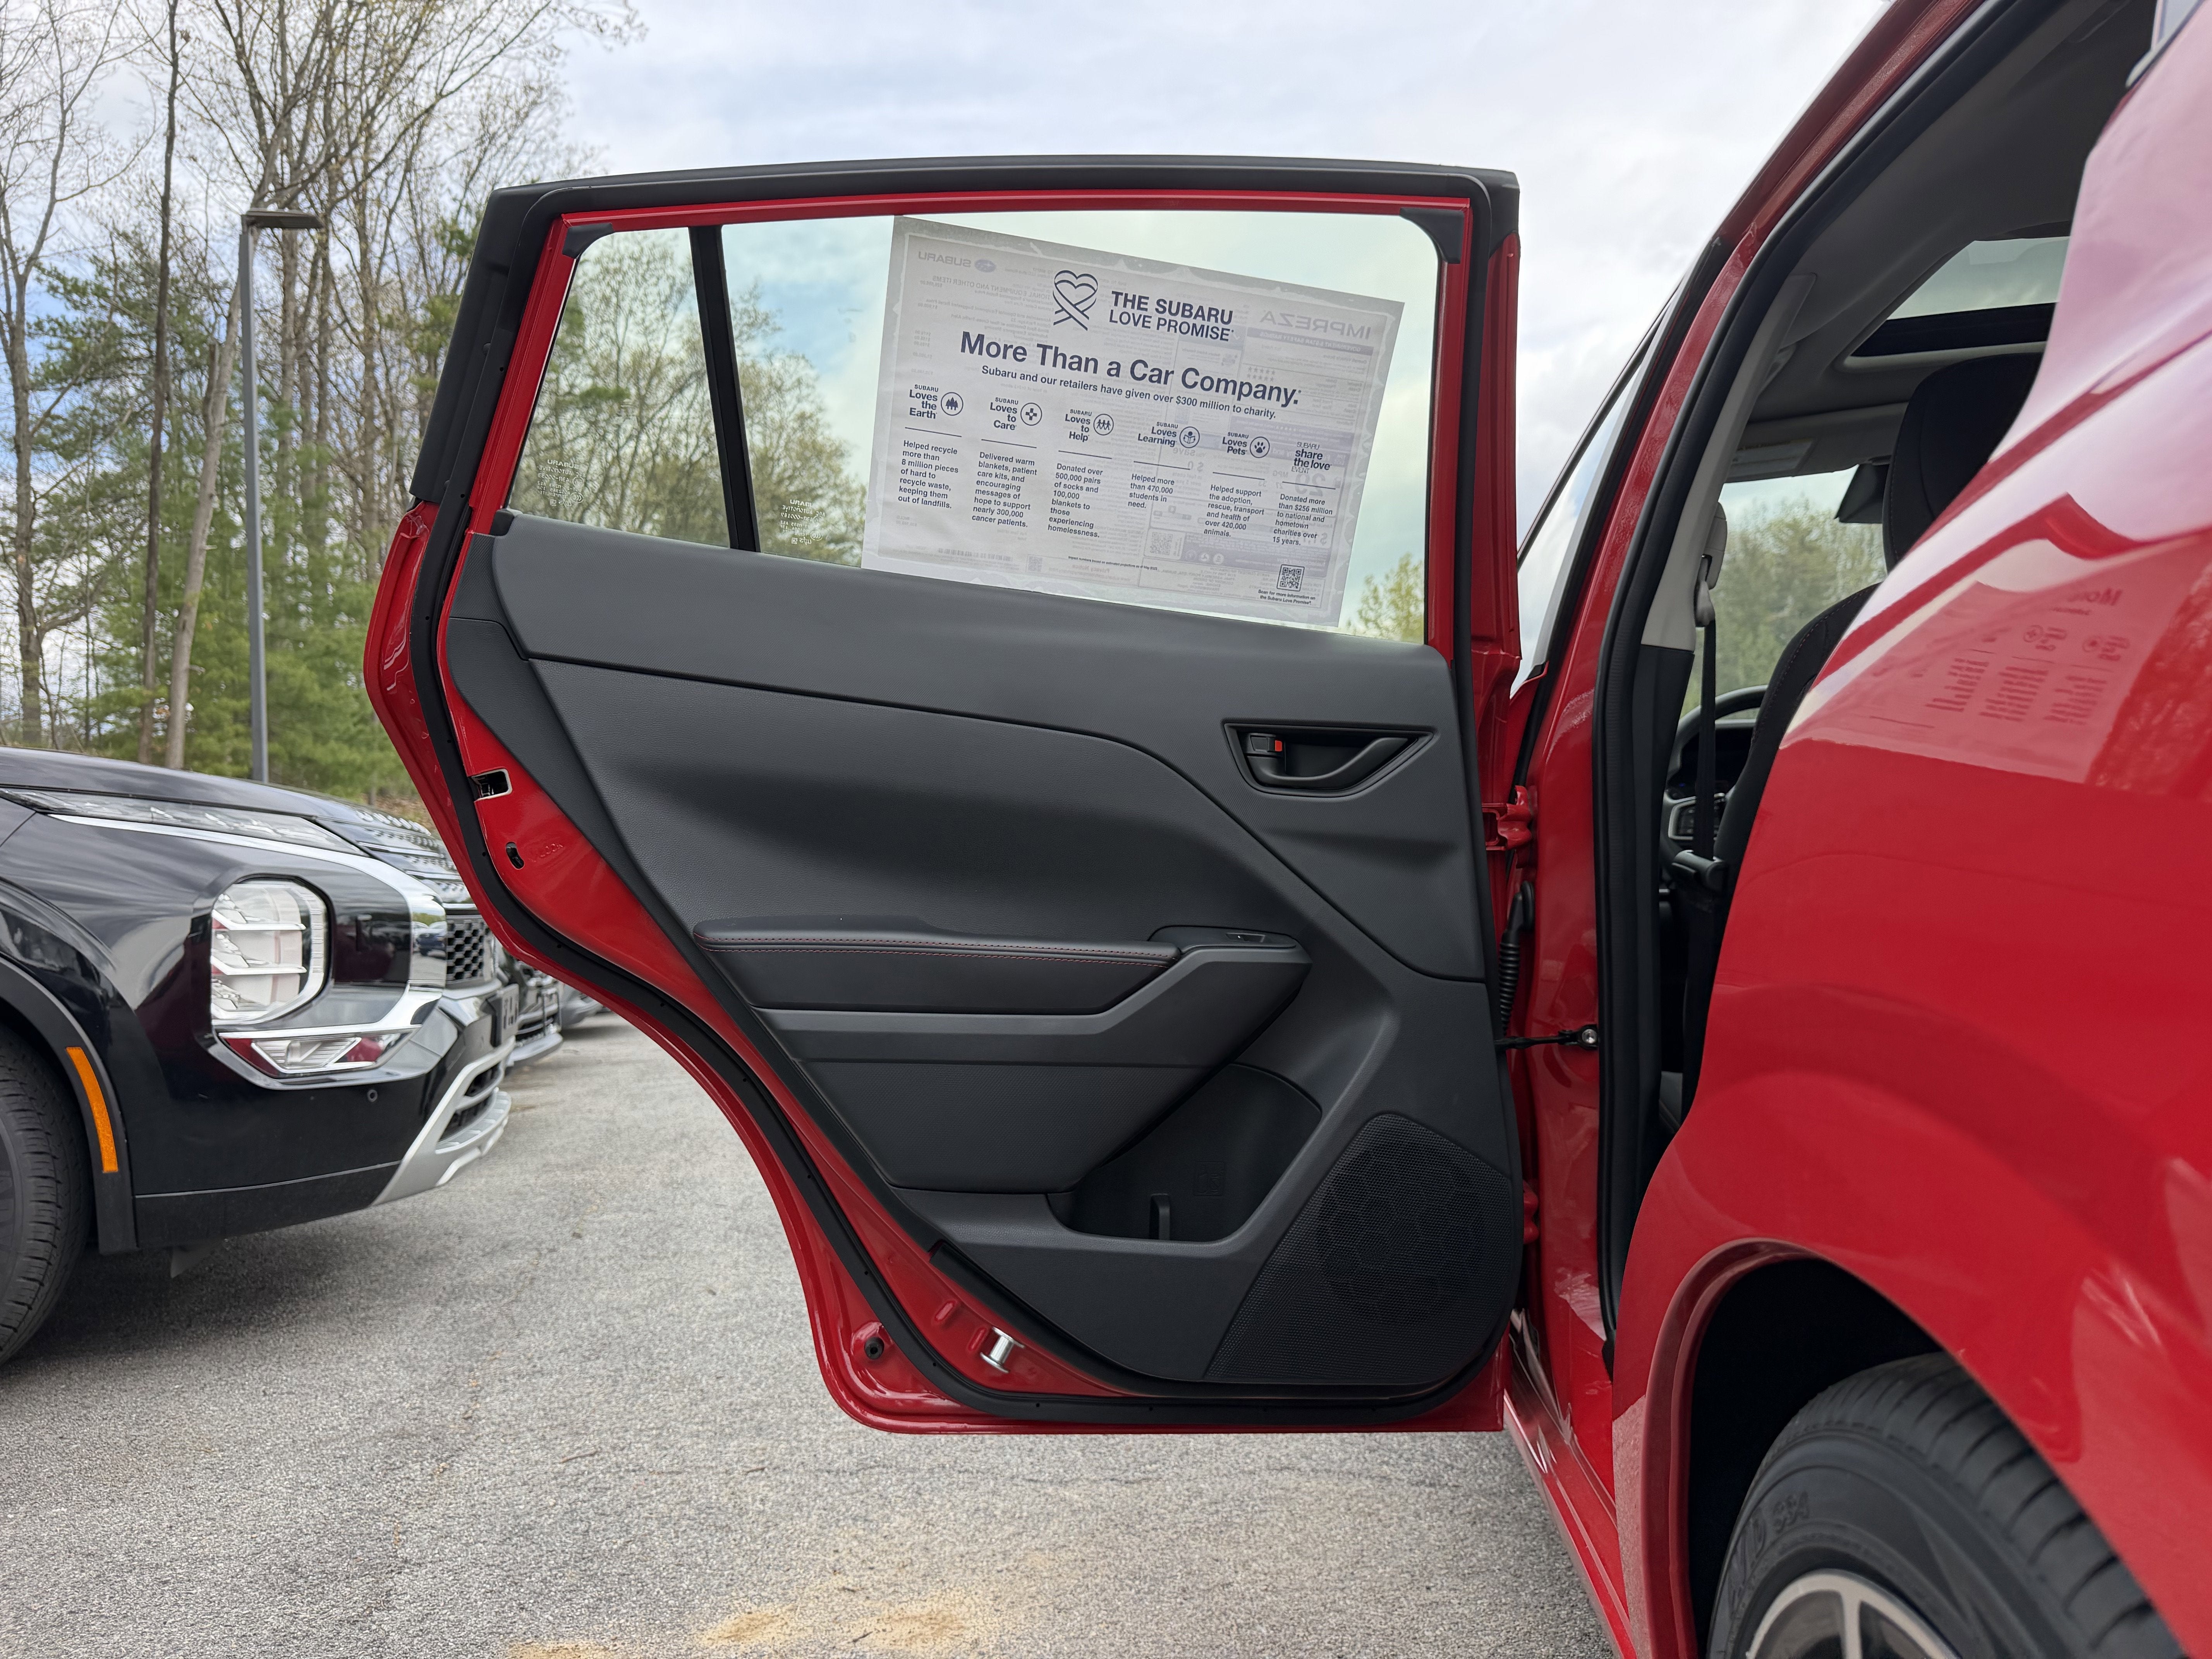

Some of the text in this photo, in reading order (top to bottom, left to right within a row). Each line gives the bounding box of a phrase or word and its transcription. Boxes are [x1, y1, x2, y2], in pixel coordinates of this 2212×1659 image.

[1111, 290, 1233, 325] THE SUBARU
[1109, 309, 1152, 329] LOVE
[960, 330, 1027, 362] More
[1036, 343, 1098, 374] Than
[1106, 361, 1121, 378] a
[1130, 359, 1175, 385] Car
[914, 384, 939, 392] SUBARU
[981, 365, 1276, 420] Subaru and our retailers have given over $300 million to charity.
[909, 389, 938, 402] Loves
[994, 397, 1018, 405] SUBARU
[921, 400, 937, 410] the
[989, 402, 1017, 414] Loves
[1006, 414, 1017, 422] to
[1065, 413, 1091, 425] Loves
[1080, 424, 1089, 433] to
[1151, 426, 1177, 438] Loves
[1222, 436, 1247, 447] Loves
[1297, 441, 1320, 450] SUBARU
[903, 440, 957, 455] Helped recycle
[923, 452, 939, 461] than
[979, 451, 1013, 463] Delivered
[1295, 448, 1323, 460] share
[907, 460, 933, 469] million
[934, 464, 958, 473] pieces
[978, 460, 1037, 476] blankets, patient
[1056, 463, 1086, 473] Donated
[1293, 457, 1310, 468] the
[910, 469, 927, 477] hard
[994, 472, 1009, 481] kits,
[1055, 472, 1082, 482] 500,000
[1131, 473, 1156, 483] Helped
[900, 477, 951, 491] recycle waste,
[976, 480, 1021, 492] encouraging
[1130, 482, 1173, 494] than 470,000
[898, 485, 948, 499] keeping them
[975, 489, 1011, 499] messages
[1053, 489, 1080, 500] 100,000
[1129, 491, 1159, 501] students
[1210, 484, 1261, 497] Helped support
[921, 498, 951, 508] landfills.
[974, 496, 992, 505] hope
[1003, 501, 1030, 510] support
[1051, 498, 1081, 508] blankets
[1221, 495, 1252, 506] adoption,
[1279, 493, 1307, 503] Donated
[972, 506, 1024, 518] nearly 300,000
[1050, 507, 1070, 516] those
[1207, 503, 1264, 515] rescue, transport
[1294, 504, 1310, 512] $256
[1220, 512, 1241, 521] health
[1285, 512, 1311, 521] national
[997, 518, 1028, 527] patients.
[1048, 517, 1094, 529] experiencing
[1221, 521, 1247, 530] 420,000
[1275, 519, 1309, 529] hometown
[1047, 524, 1099, 538] homelessness.
[1203, 528, 1231, 537] animals.
[1273, 528, 1301, 537] charities
